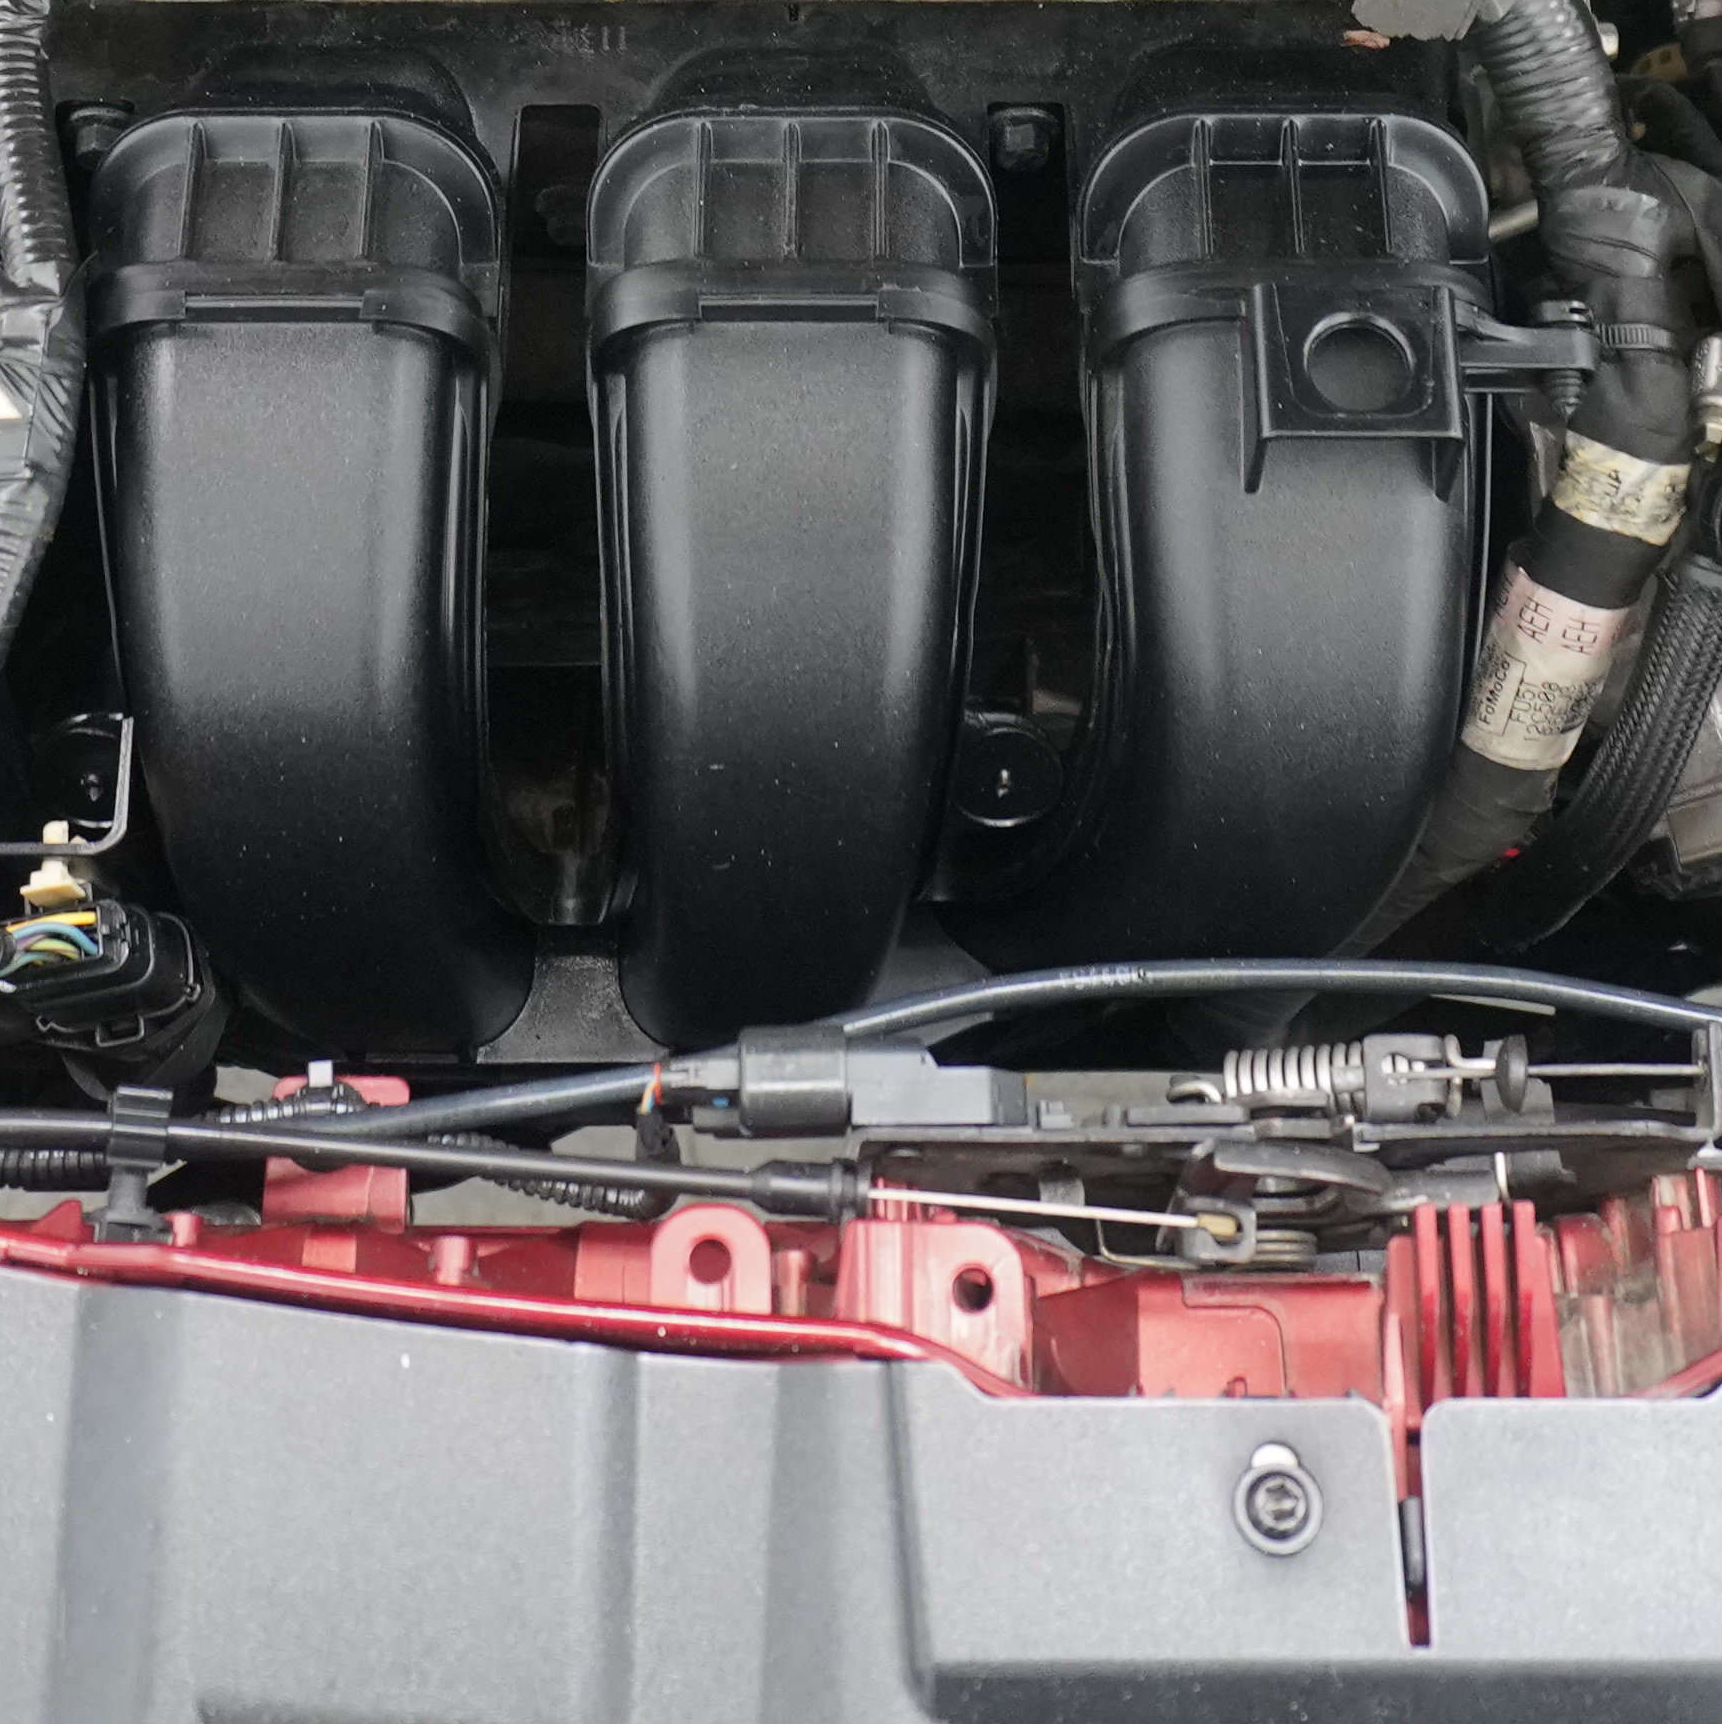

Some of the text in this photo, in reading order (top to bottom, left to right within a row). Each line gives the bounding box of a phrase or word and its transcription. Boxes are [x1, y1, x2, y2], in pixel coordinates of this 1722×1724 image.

[1518, 599, 1554, 645] AEH
[1560, 618, 1600, 656] AEH
[1479, 658, 1511, 728] FoMoCo
